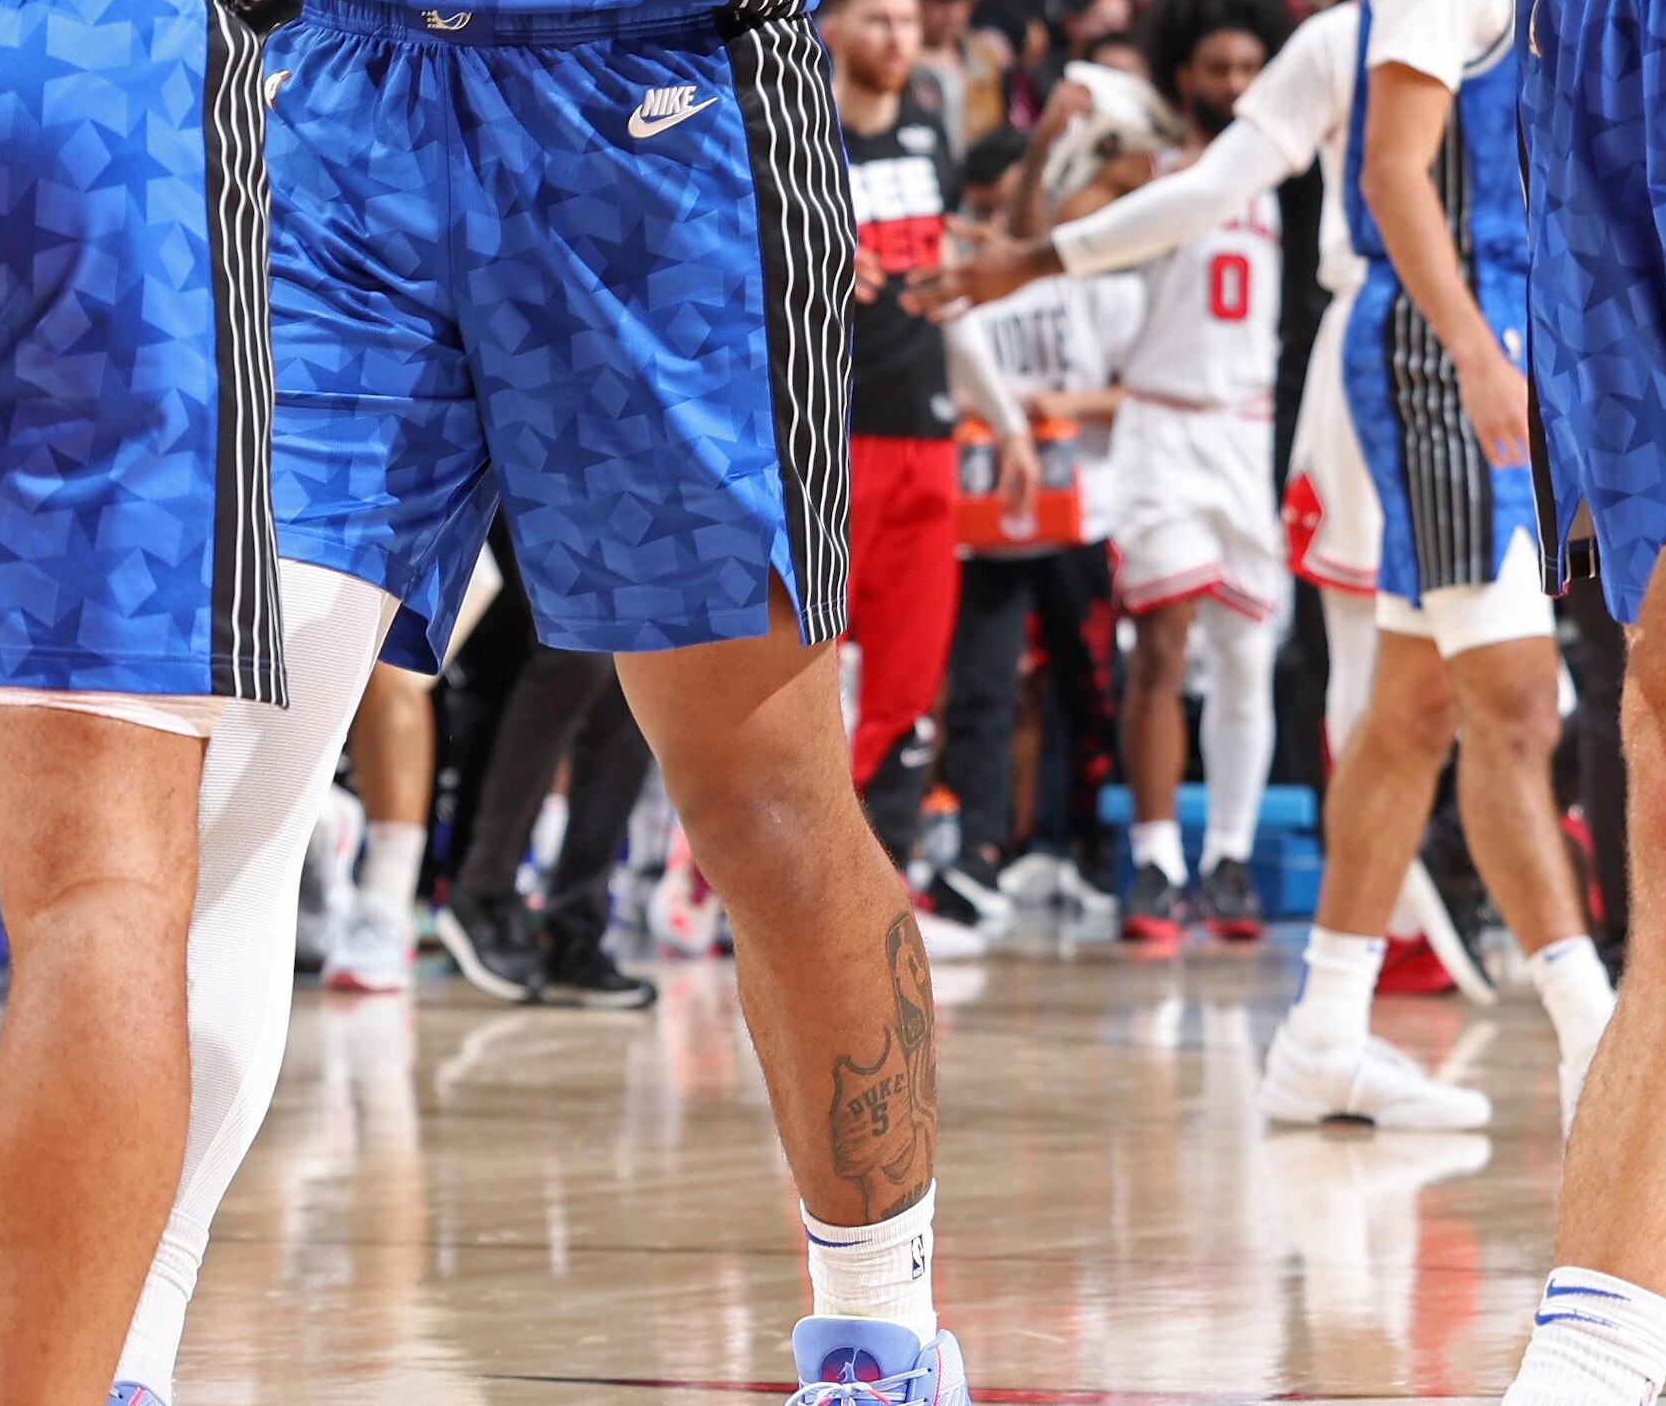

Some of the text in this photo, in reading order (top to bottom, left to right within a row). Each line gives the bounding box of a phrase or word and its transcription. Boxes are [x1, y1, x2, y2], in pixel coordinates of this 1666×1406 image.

[641, 84, 697, 117] NIKE
[1208, 251, 1250, 322] 0
[846, 1073, 906, 1115] DUKE
[871, 1101, 890, 1136] 5
